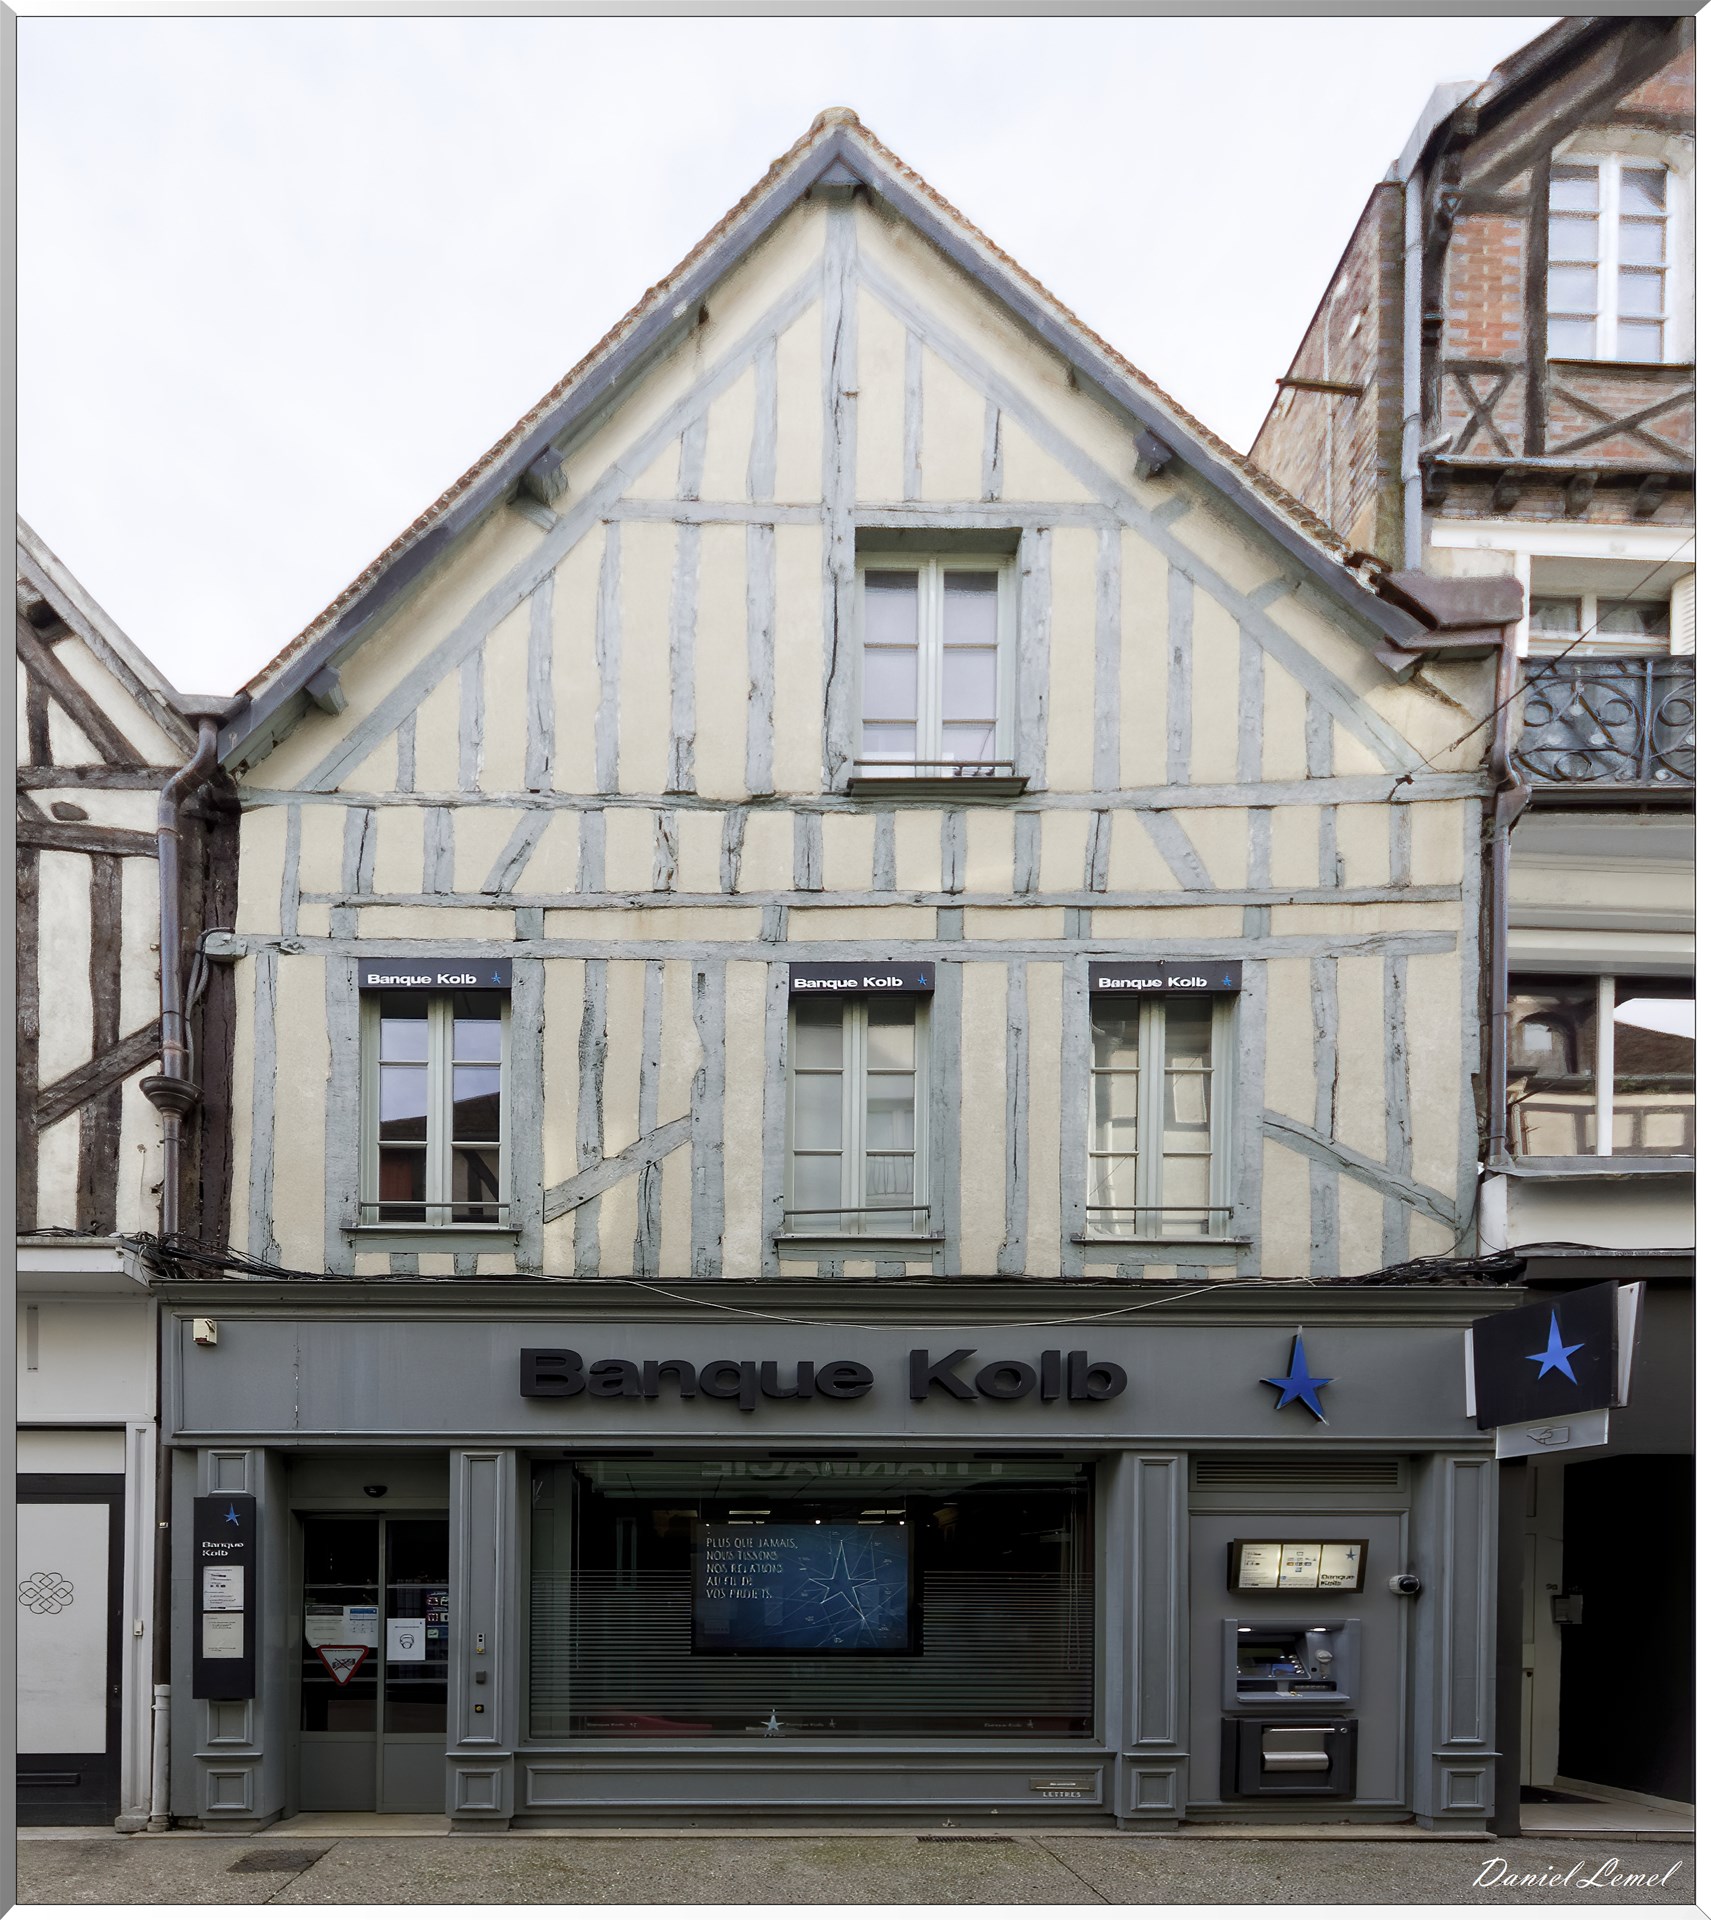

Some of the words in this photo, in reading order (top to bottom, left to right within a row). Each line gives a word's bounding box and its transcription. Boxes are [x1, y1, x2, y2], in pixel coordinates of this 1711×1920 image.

[367, 974, 432, 986] Banque
[437, 973, 477, 984] Kolb
[794, 978, 858, 989] Banque
[863, 977, 903, 987] Kolb
[1098, 977, 1162, 989] Banque
[1168, 976, 1208, 987] Kolb
[520, 1348, 875, 1411] Banque
[909, 1349, 1128, 1401] Kolb
[202, 1541, 244, 1549] Banque
[706, 1538, 731, 1548] PLUS
[706, 1564, 728, 1573] NOS
